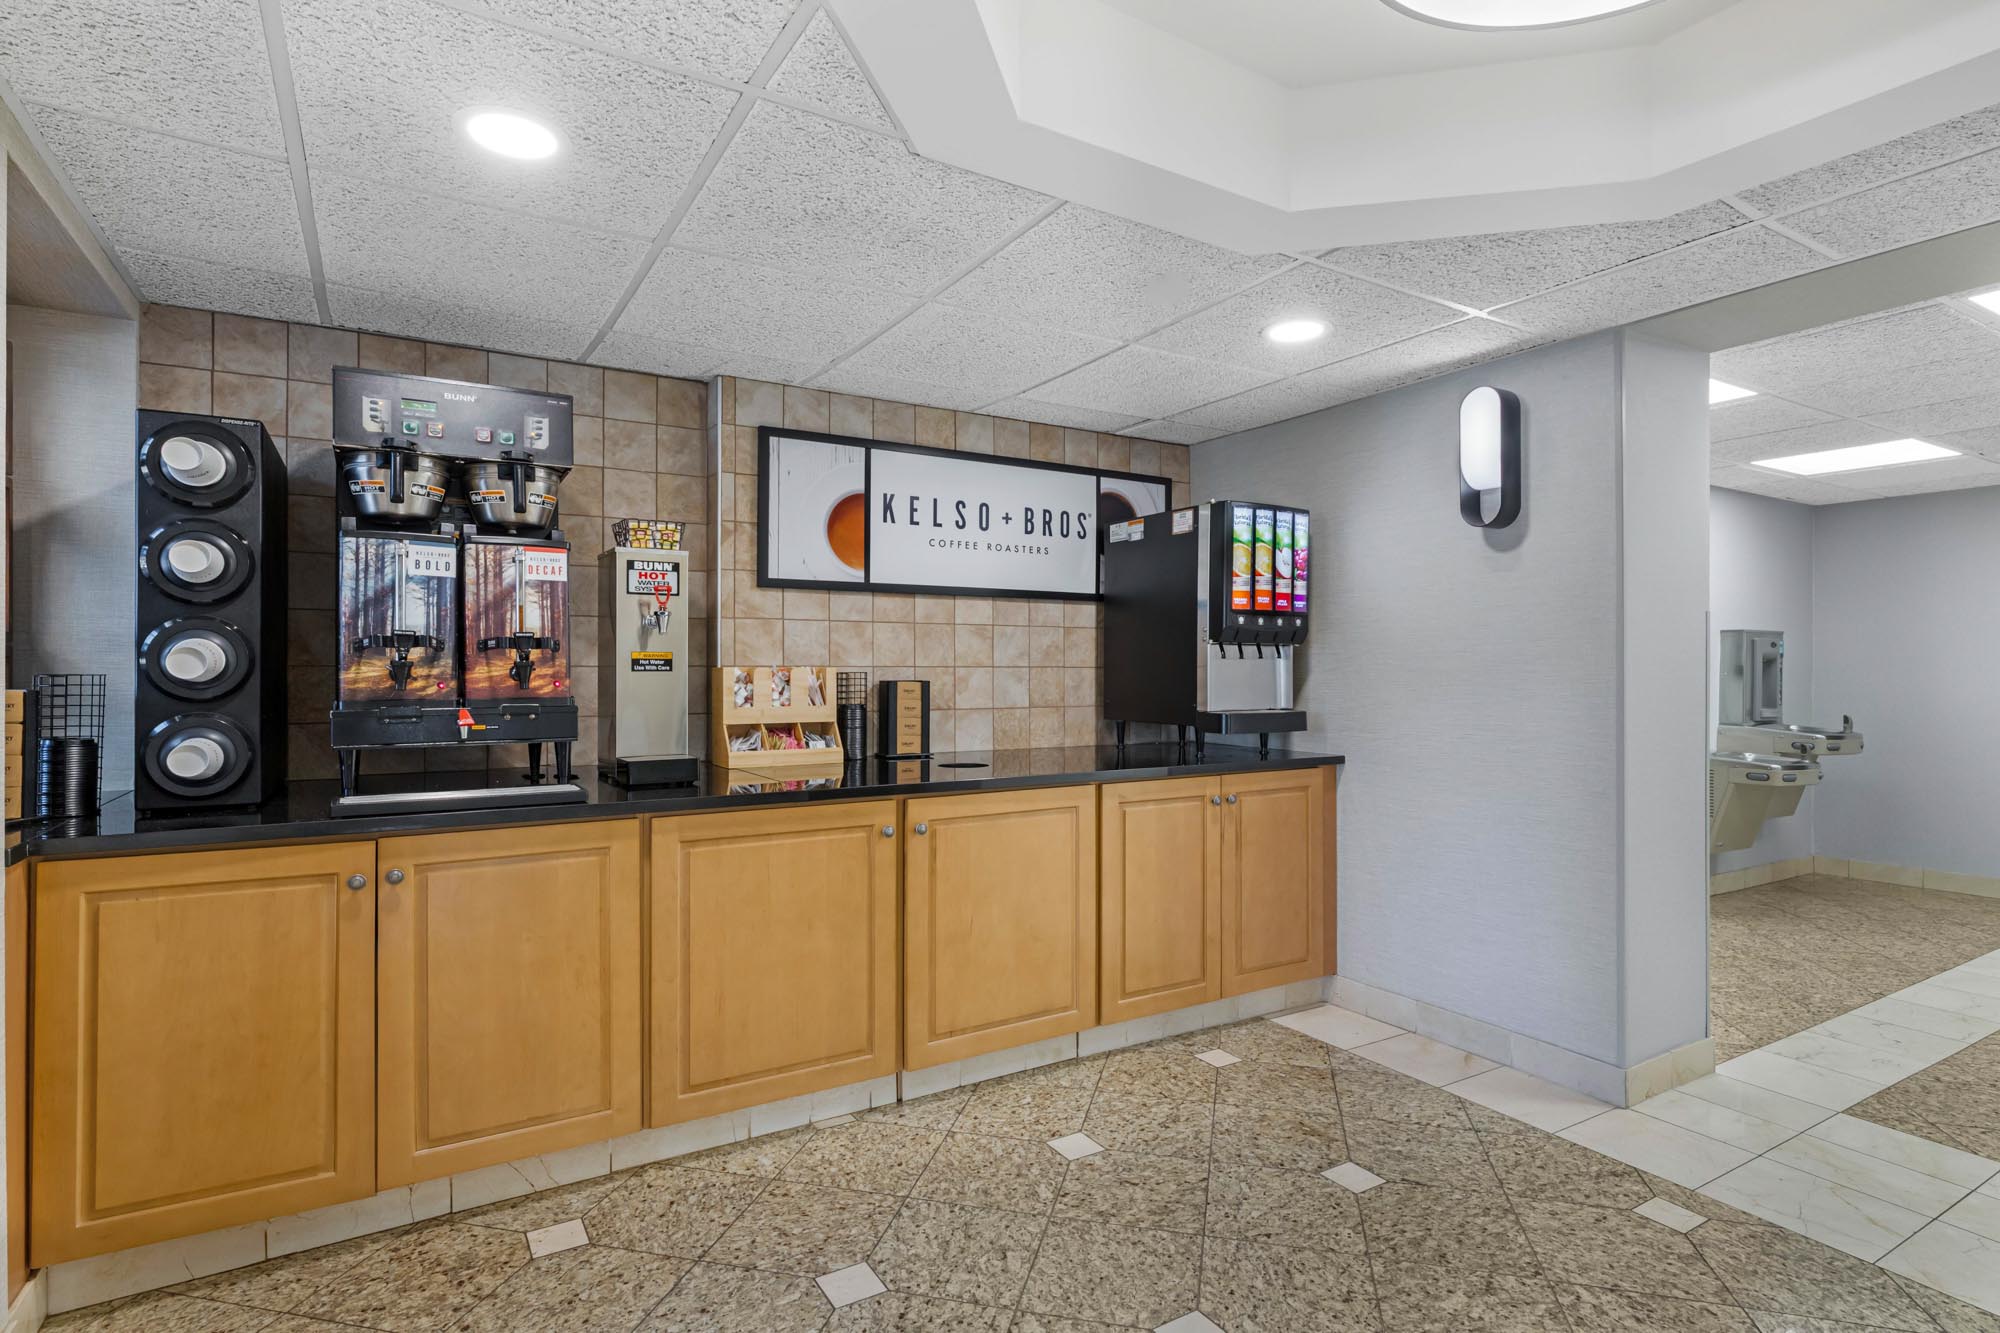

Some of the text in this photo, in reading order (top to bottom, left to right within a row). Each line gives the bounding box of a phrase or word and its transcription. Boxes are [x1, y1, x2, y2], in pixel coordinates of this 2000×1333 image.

[444, 392, 476, 402] BUNN
[882, 493, 990, 532] KELSO
[1024, 507, 1088, 540] BROS
[928, 538, 1050, 555] COFFEE ROASTERS
[414, 559, 451, 572] BOLD
[527, 564, 563, 576] DECAF
[634, 561, 673, 571] BUNN
[638, 571, 668, 580] HOT
